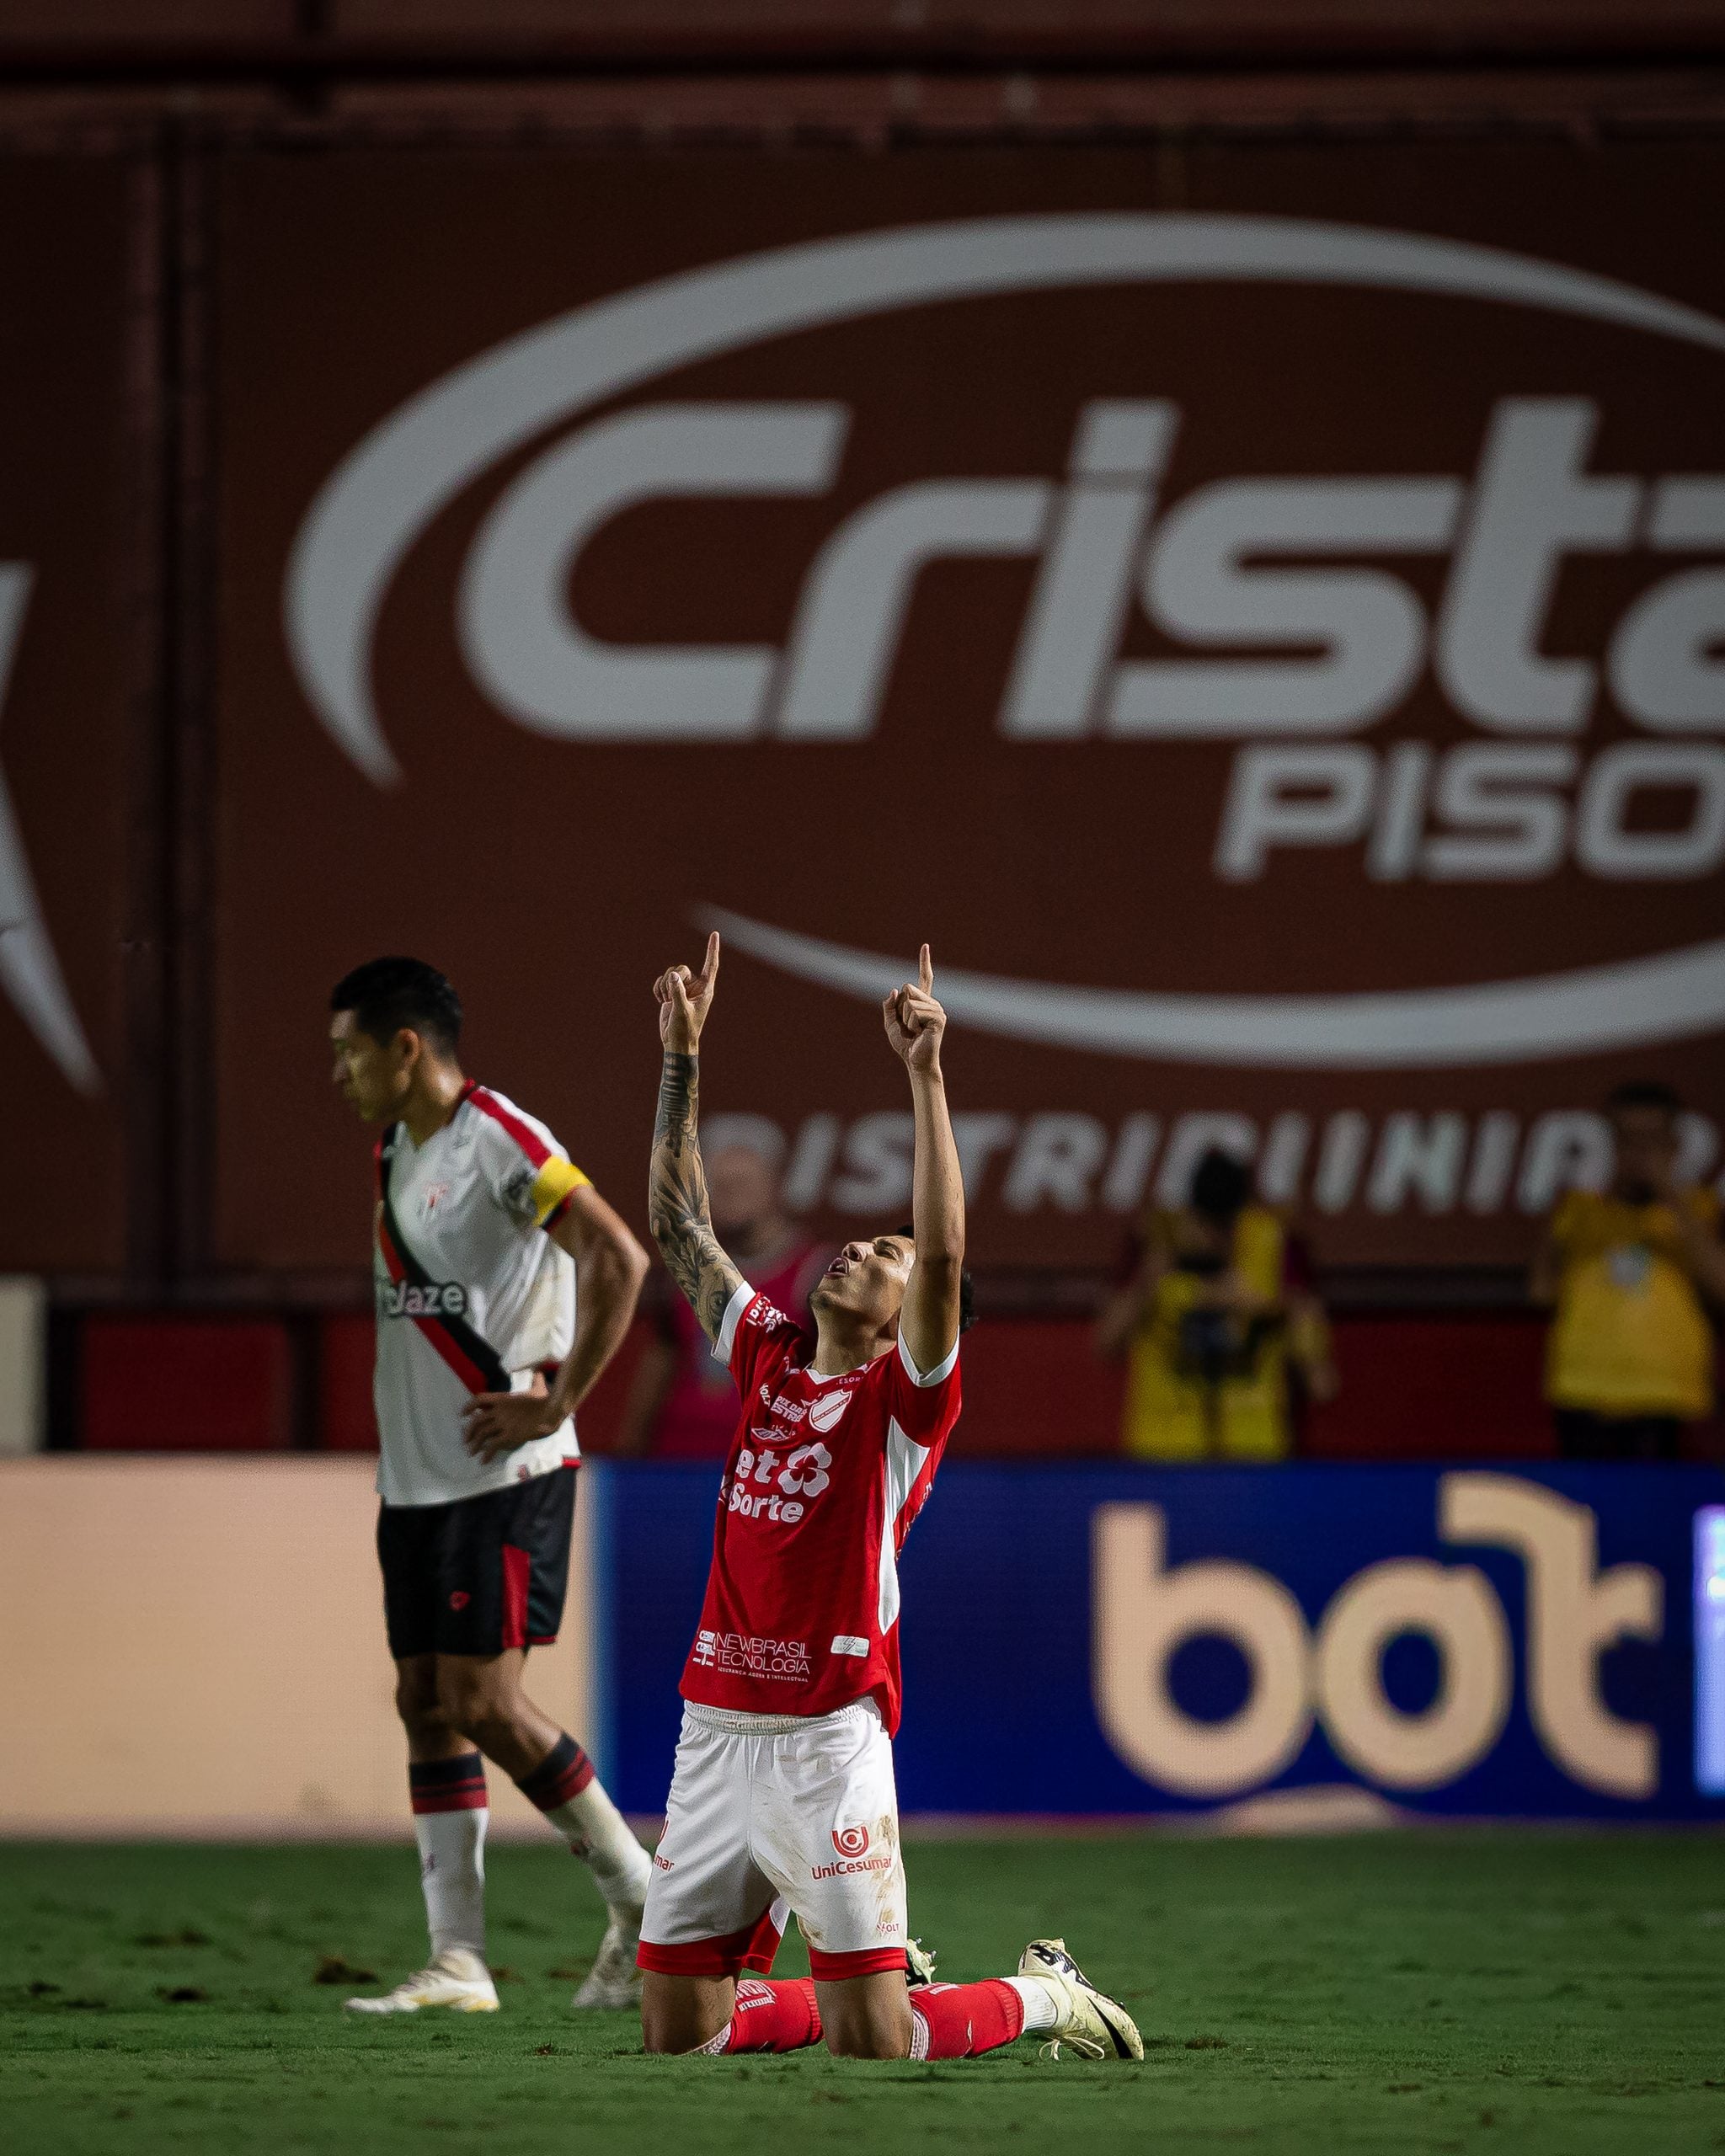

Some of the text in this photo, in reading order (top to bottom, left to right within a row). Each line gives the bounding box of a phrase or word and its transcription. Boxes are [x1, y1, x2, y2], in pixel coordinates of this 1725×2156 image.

[1215, 743, 1725, 882] PISO
[735, 1449, 780, 1484] et
[728, 1482, 804, 1523] Sorte
[716, 1649, 810, 1674] TECNOLOGIA
[654, 1854, 676, 1871] mar
[810, 1857, 892, 1881] UniCesumar
